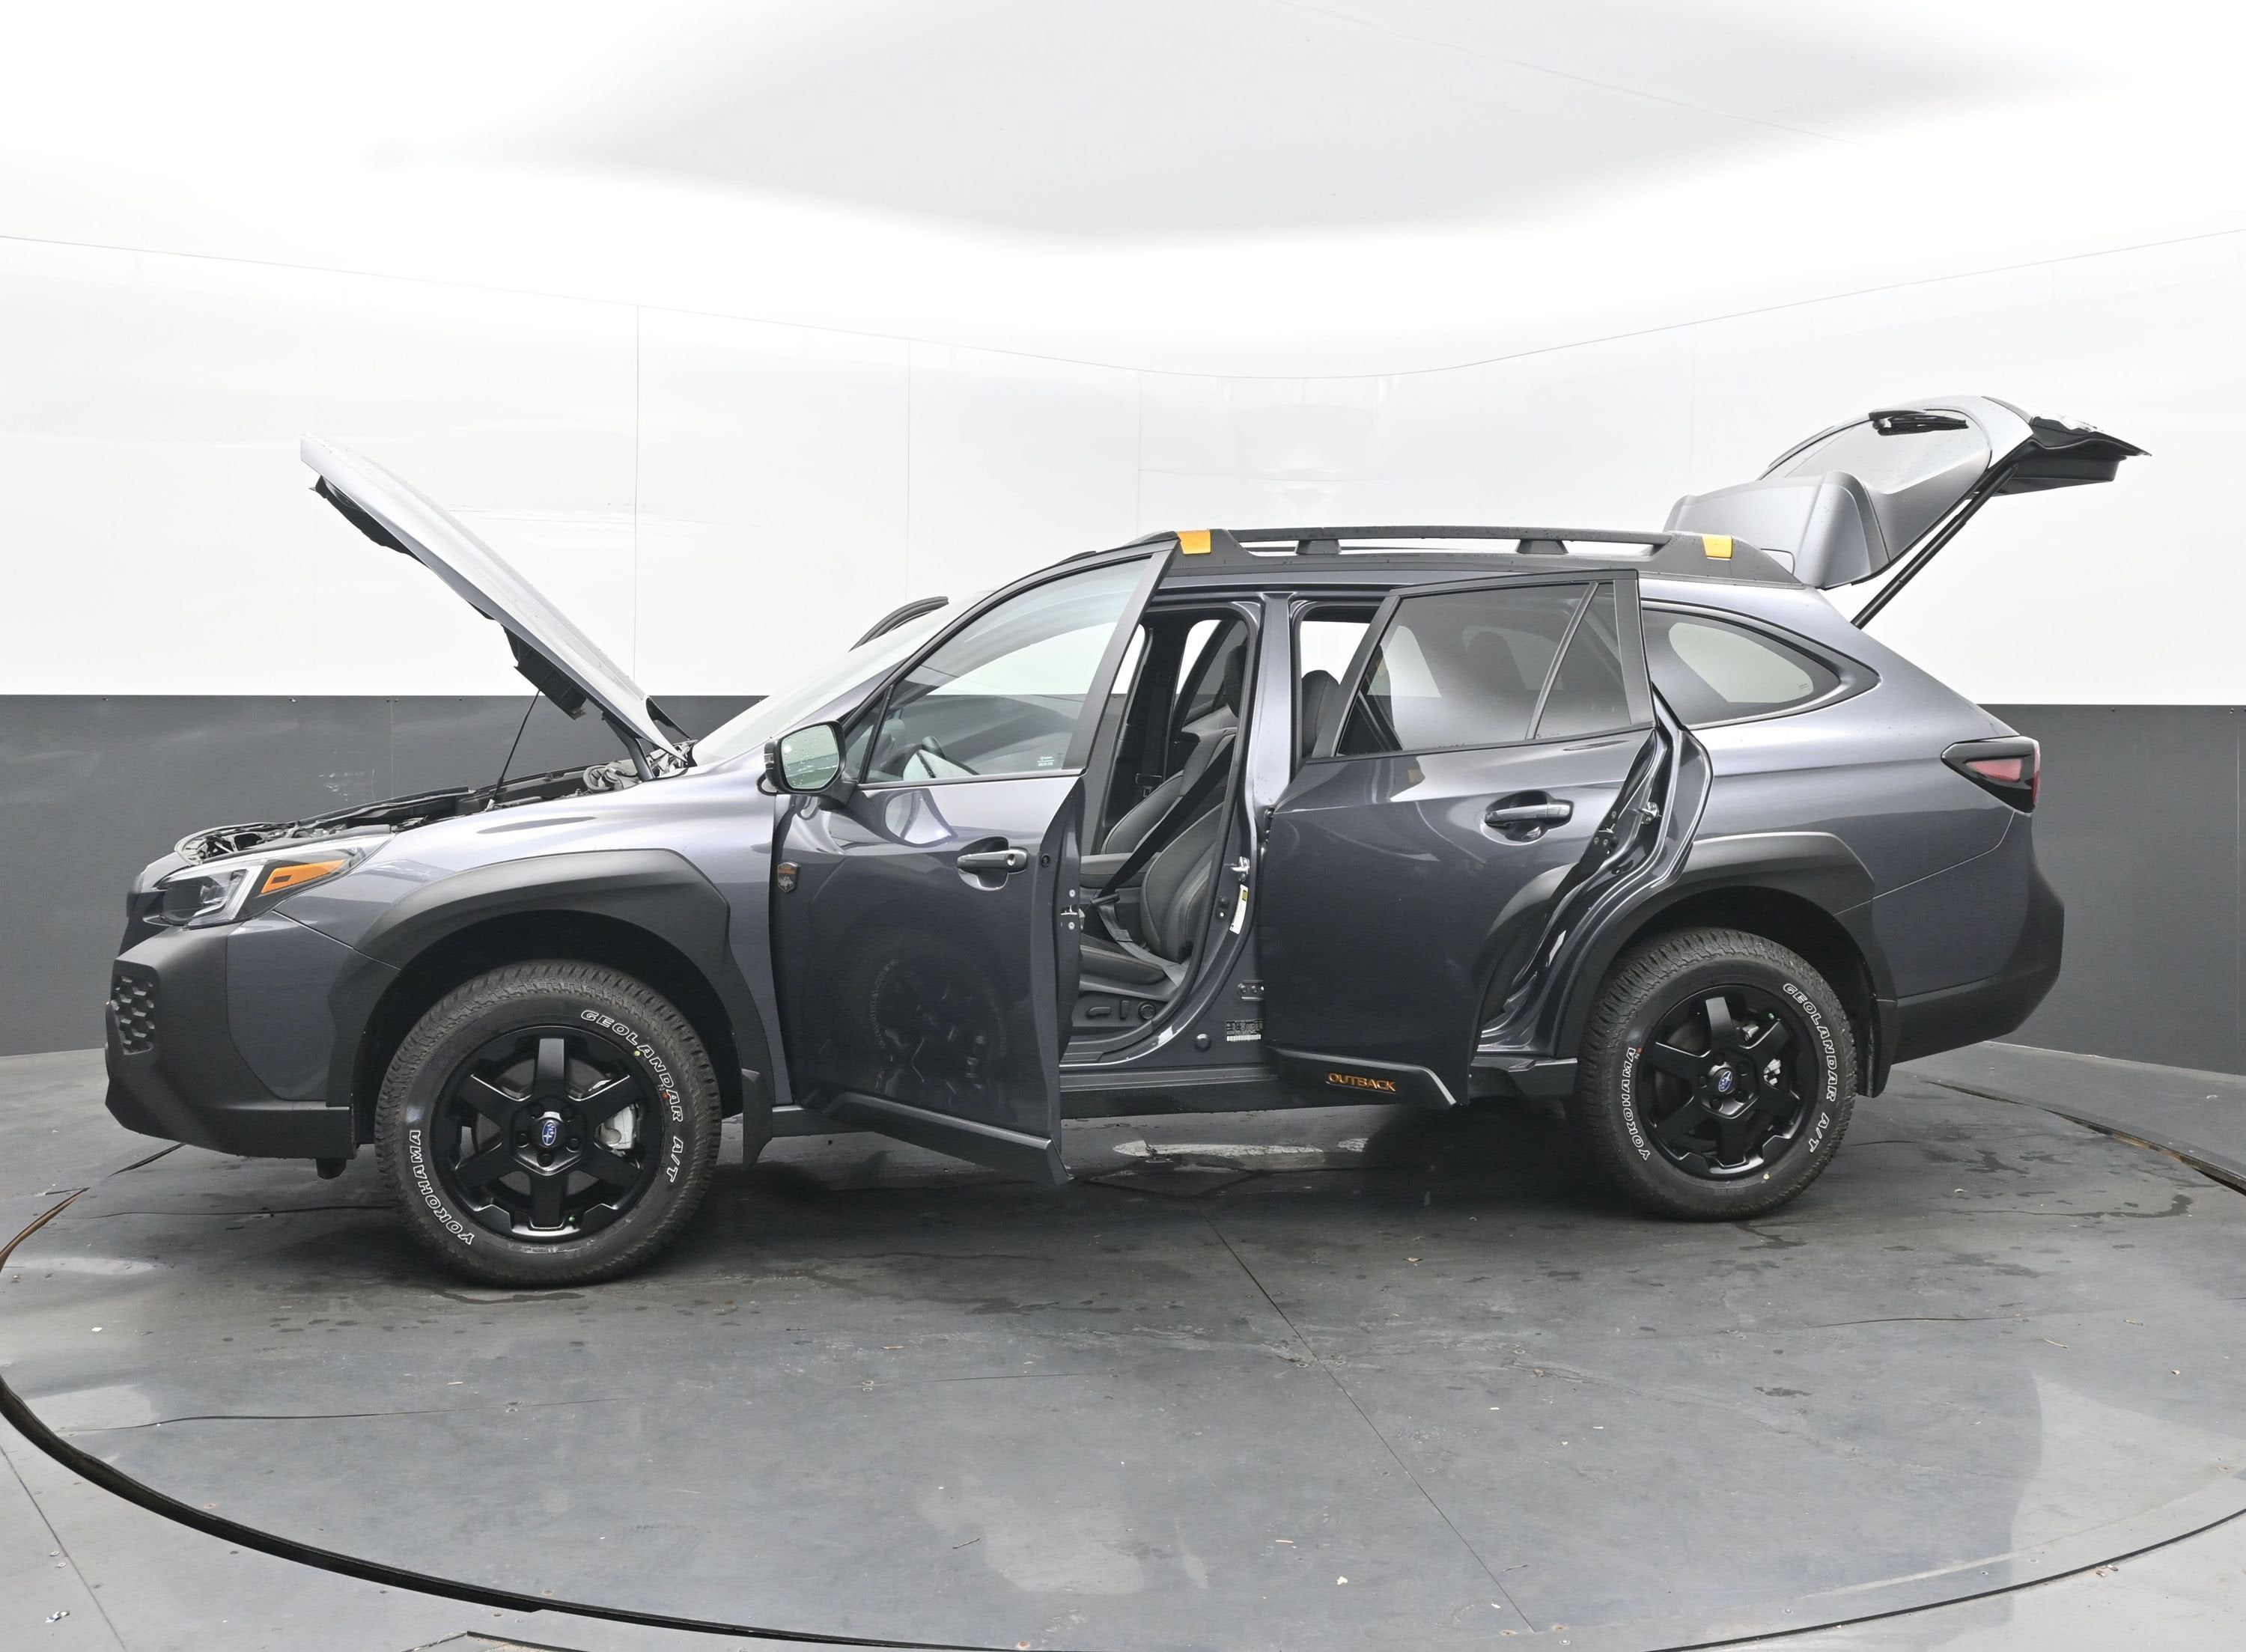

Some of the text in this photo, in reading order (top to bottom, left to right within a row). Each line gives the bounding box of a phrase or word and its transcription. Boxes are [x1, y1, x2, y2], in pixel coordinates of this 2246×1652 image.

[580, 1009, 684, 1183] GEOLANDAR A/T
[1329, 1073, 1396, 1092] OUTBACK
[1622, 1047, 1650, 1160] YOKOHAMA
[1783, 983, 1838, 1153] GEOLANDAR A/T
[410, 1130, 476, 1245] YOKOHAMA
